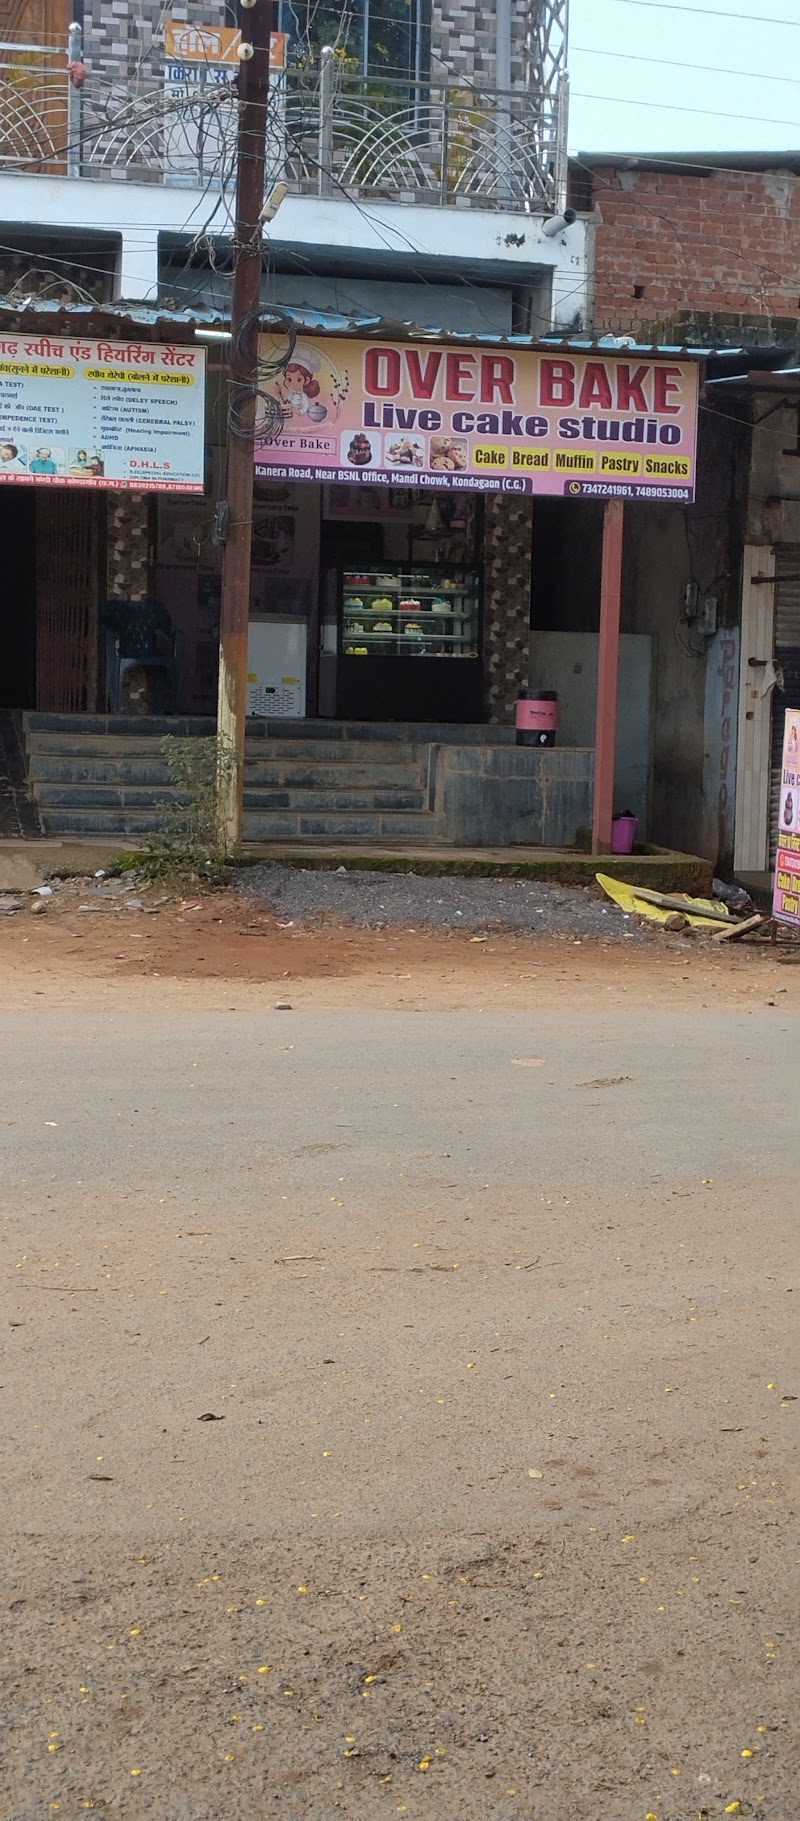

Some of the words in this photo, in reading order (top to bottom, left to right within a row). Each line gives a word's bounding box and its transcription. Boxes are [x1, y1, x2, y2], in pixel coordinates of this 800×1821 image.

[24, 338, 64, 358] स्पीच
[69, 340, 92, 361] एंड
[97, 342, 156, 364] हियरिंग
[160, 346, 195, 367] सेंटर
[364, 346, 514, 404] OVER
[540, 358, 683, 414] BAKE
[364, 402, 441, 431] Live
[453, 410, 549, 437] cake
[558, 416, 682, 446] studio
[264, 436, 295, 448] Over
[300, 439, 331, 450] Bake
[475, 449, 505, 464] Cake
[512, 451, 549, 466] Bread
[556, 453, 594, 469] Muffin
[601, 455, 639, 473] Pastry
[646, 458, 688, 475] Snacks
[255, 465, 287, 477] Kanera
[288, 467, 314, 480] Road,
[315, 469, 336, 480] Near
[338, 470, 361, 482] BSNL
[362, 471, 390, 484] Office,
[391, 473, 418, 484] Mandi
[419, 475, 451, 487] Chowk,
[452, 477, 500, 489] Kondagaon
[501, 477, 526, 491] (C.G.)
[582, 483, 634, 497] 7347241961,
[636, 486, 689, 499] 7489053004
